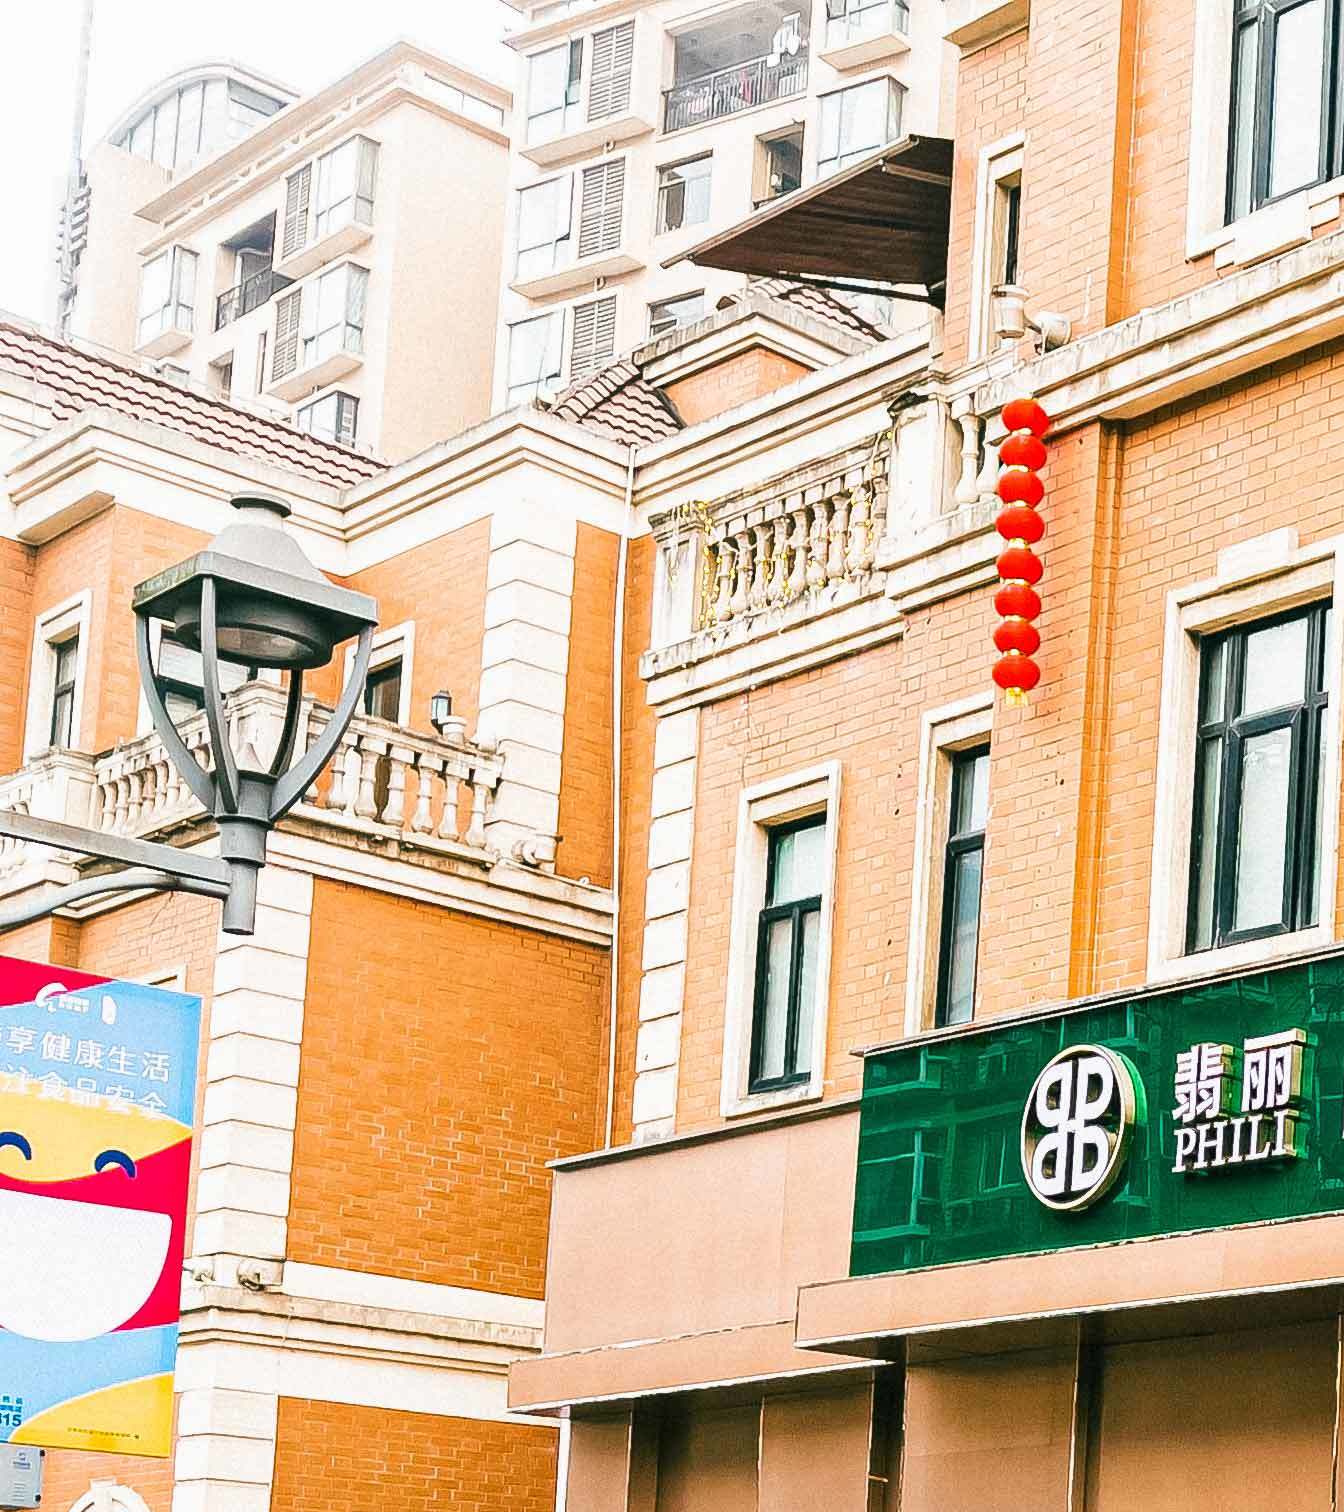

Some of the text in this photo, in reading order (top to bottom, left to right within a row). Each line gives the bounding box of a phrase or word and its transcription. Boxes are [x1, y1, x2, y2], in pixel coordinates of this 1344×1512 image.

[0, 1025, 171, 1083] 享健康生活
[1172, 1028, 1307, 1122] 翡丽
[1172, 1108, 1300, 1173] PHILI
